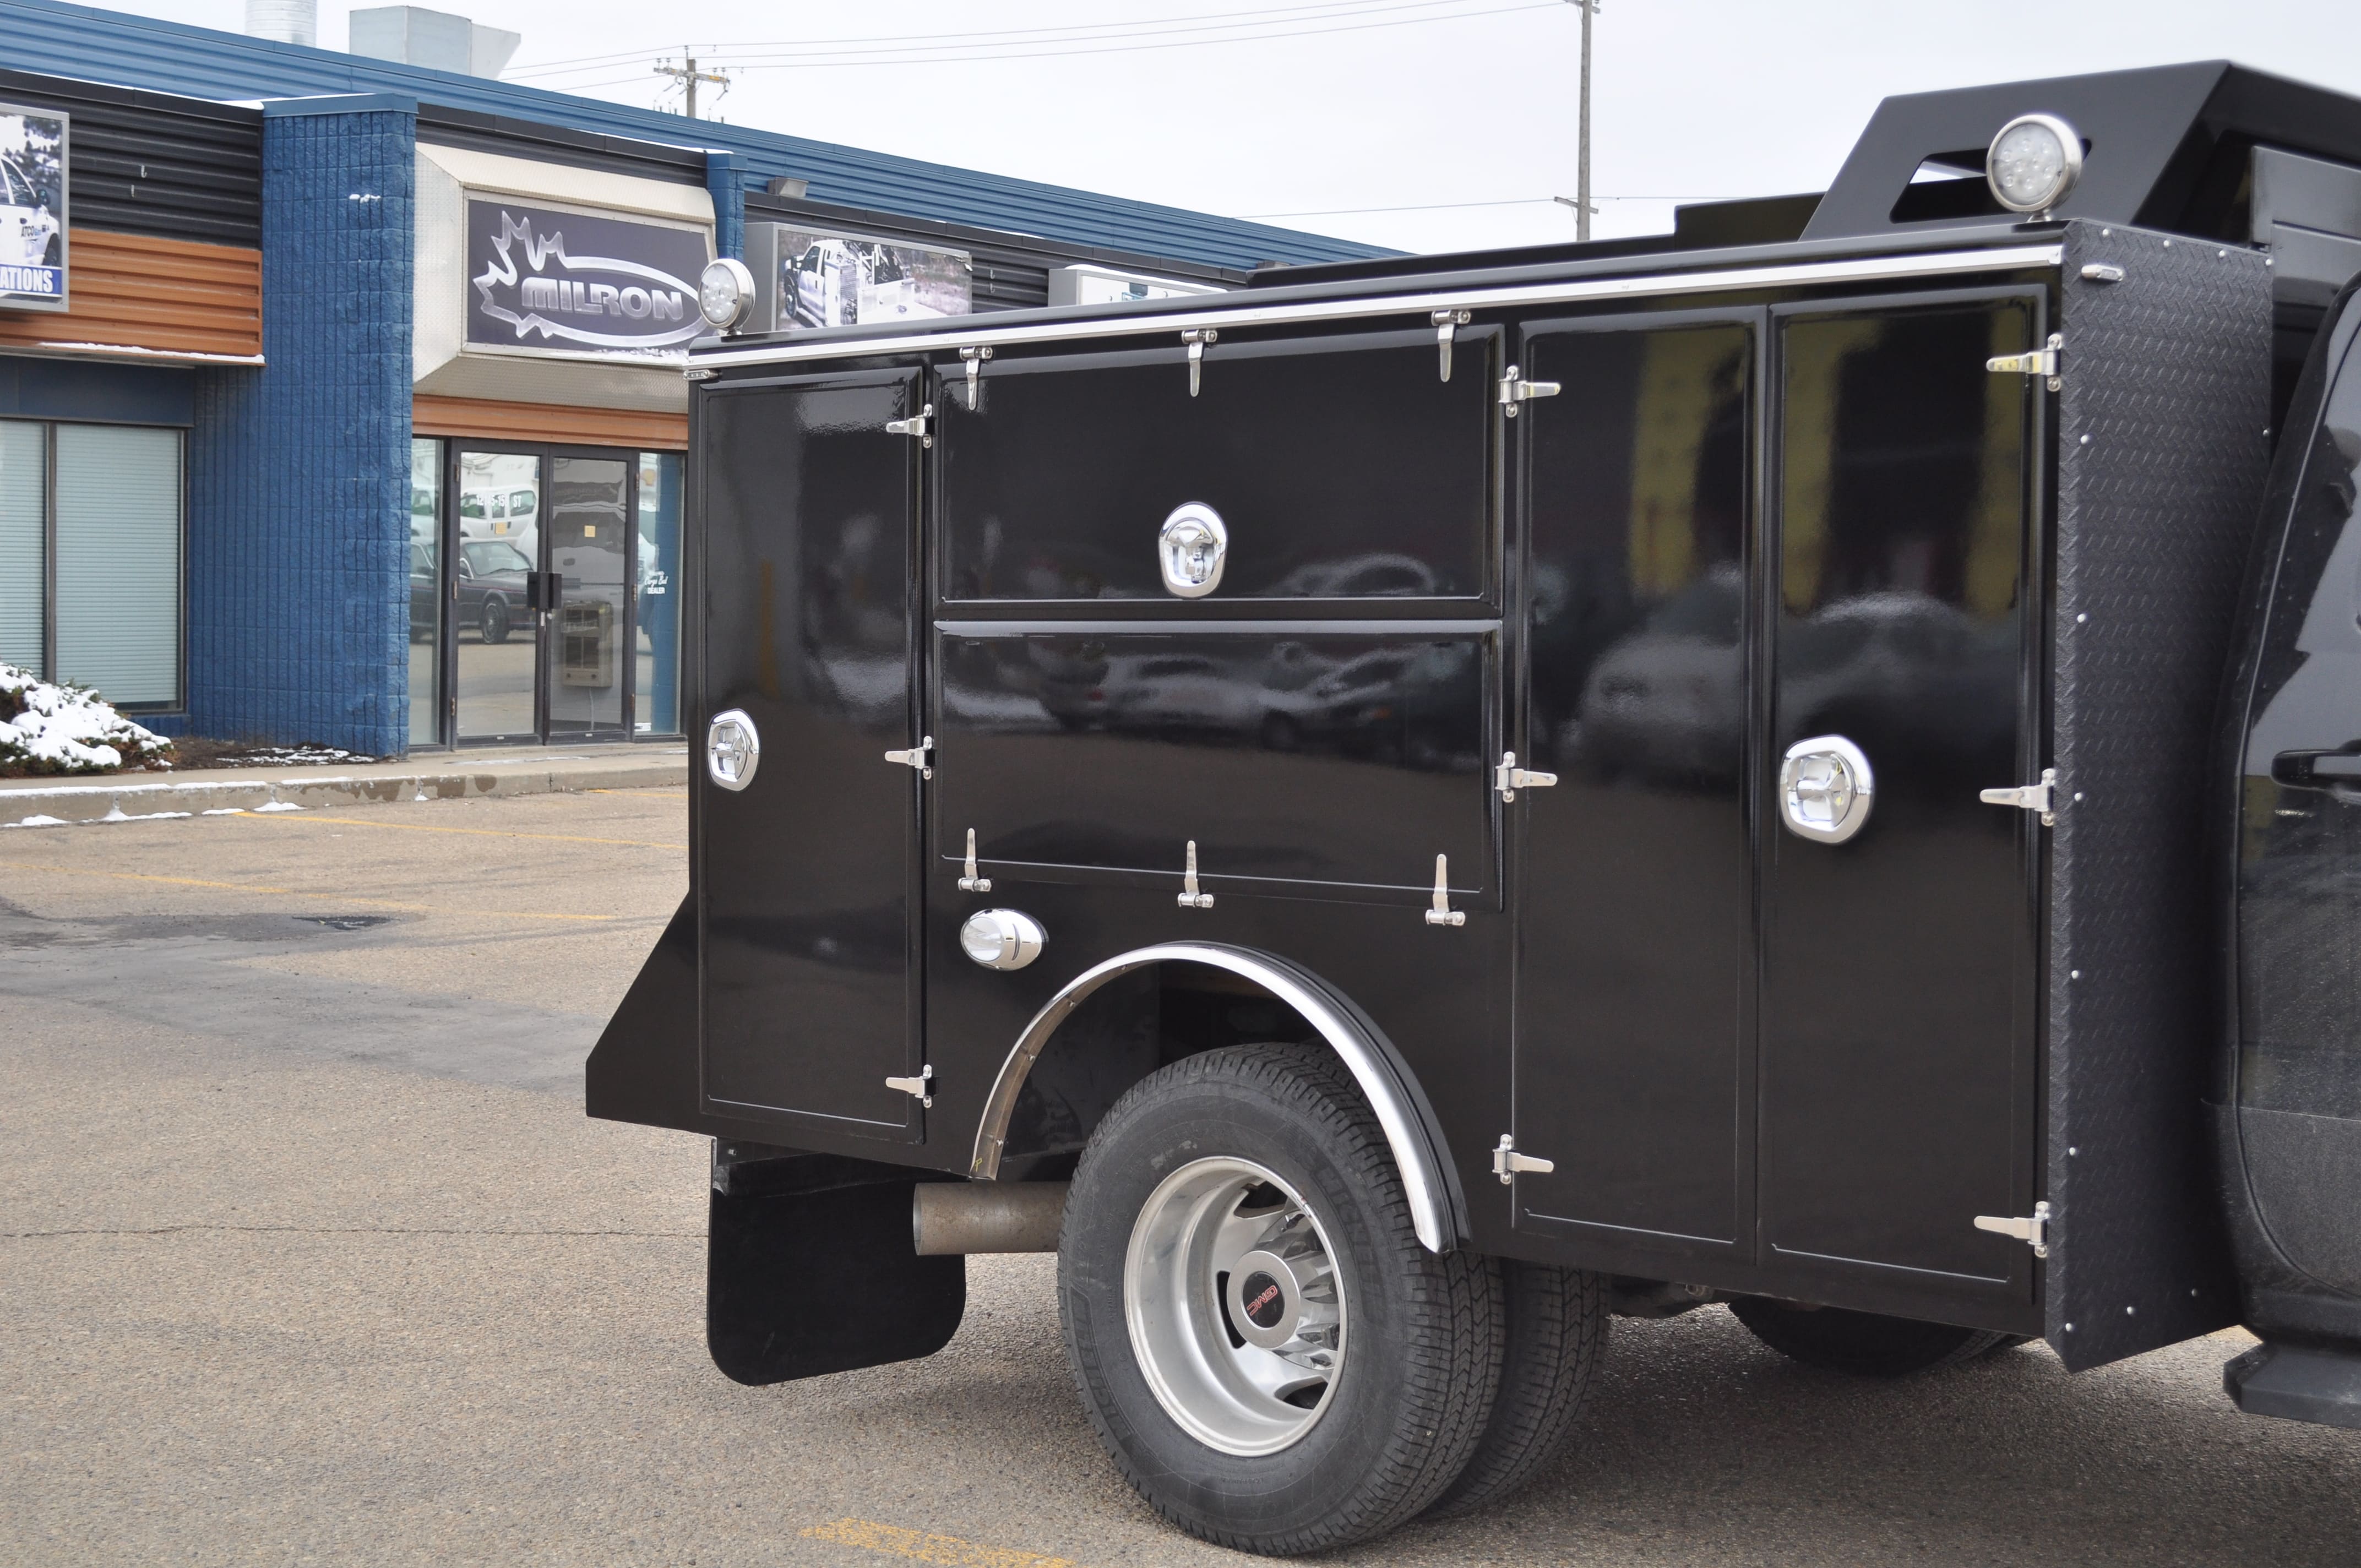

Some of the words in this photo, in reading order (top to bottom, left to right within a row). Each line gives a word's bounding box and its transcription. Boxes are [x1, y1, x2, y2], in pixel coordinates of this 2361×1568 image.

[521, 276, 684, 322] MILRON
[513, 495, 522, 508] ST
[1246, 1284, 1278, 1316] GMC
